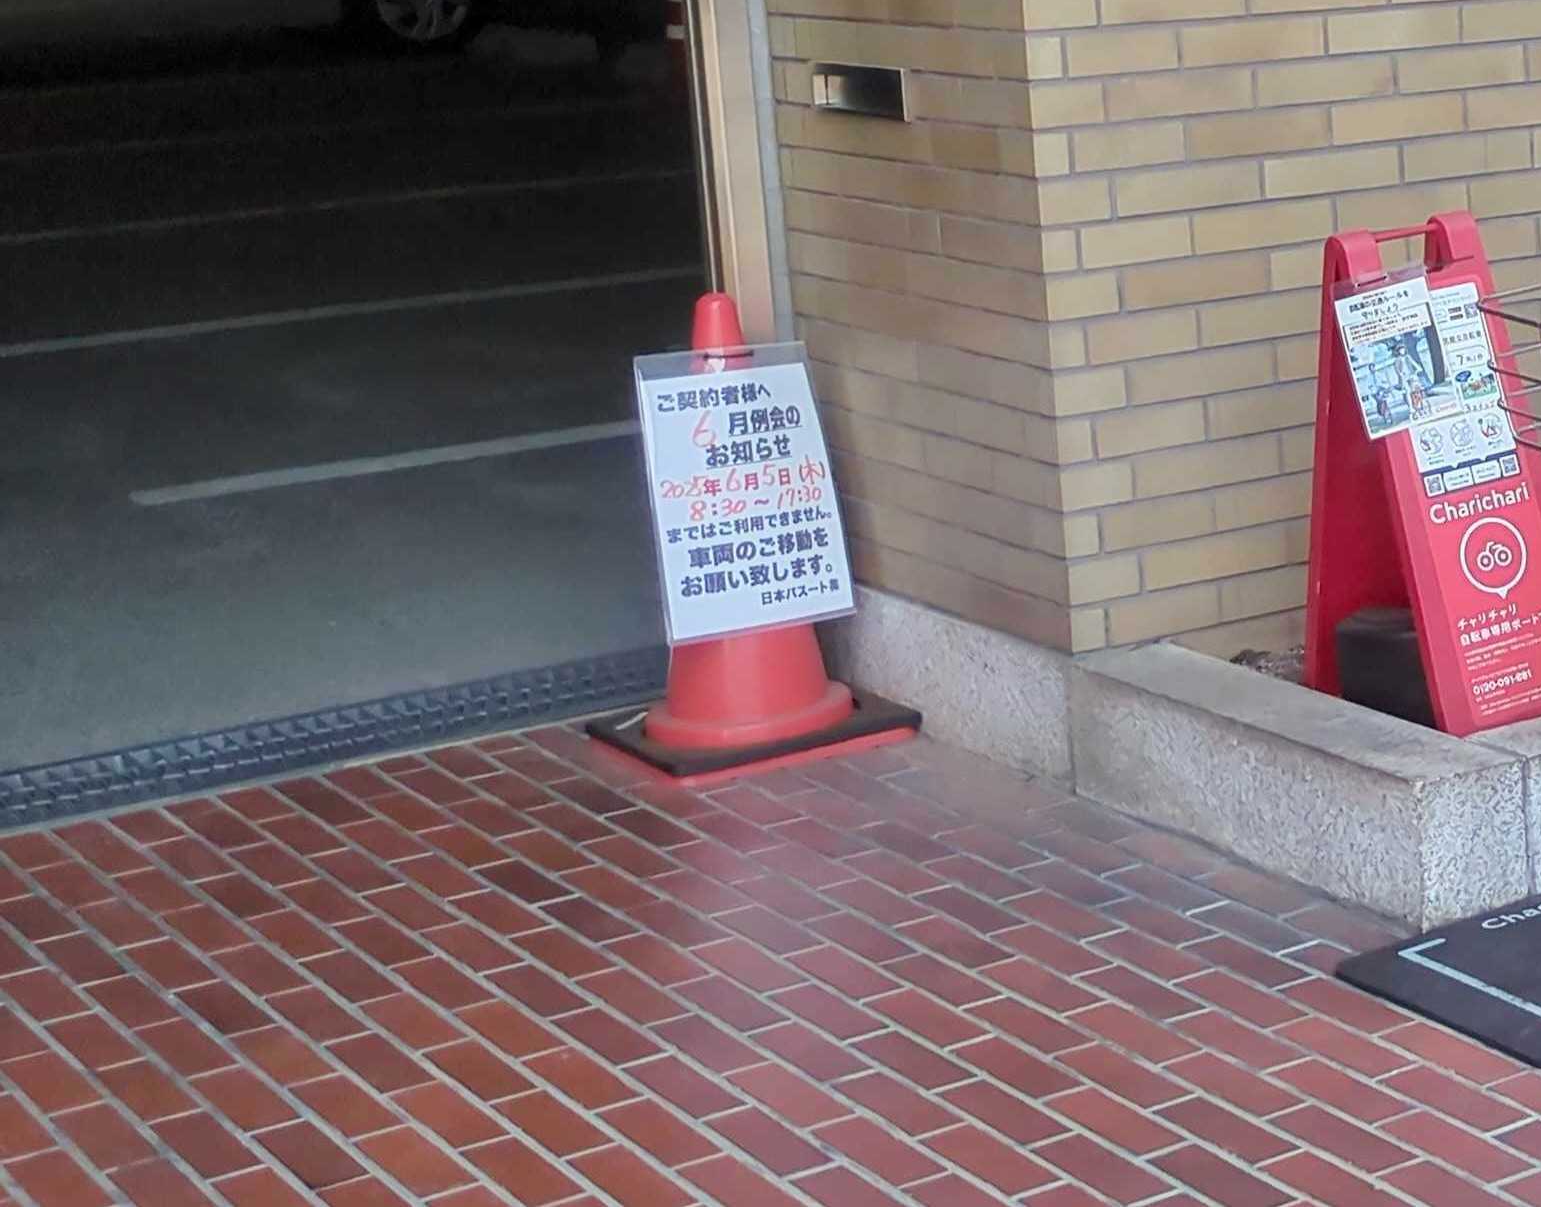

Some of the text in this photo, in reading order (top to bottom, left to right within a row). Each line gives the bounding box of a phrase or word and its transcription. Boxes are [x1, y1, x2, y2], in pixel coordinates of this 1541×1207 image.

[657, 383, 772, 413] ご契約者様へ
[706, 434, 792, 466] お知らせ
[1429, 482, 1530, 524] Charichari
[666, 506, 832, 544] まではご利用できません。
[688, 527, 829, 569] 車両のご移動を
[681, 554, 833, 597] お願い致します。
[1458, 603, 1517, 631] チャリチャリ
